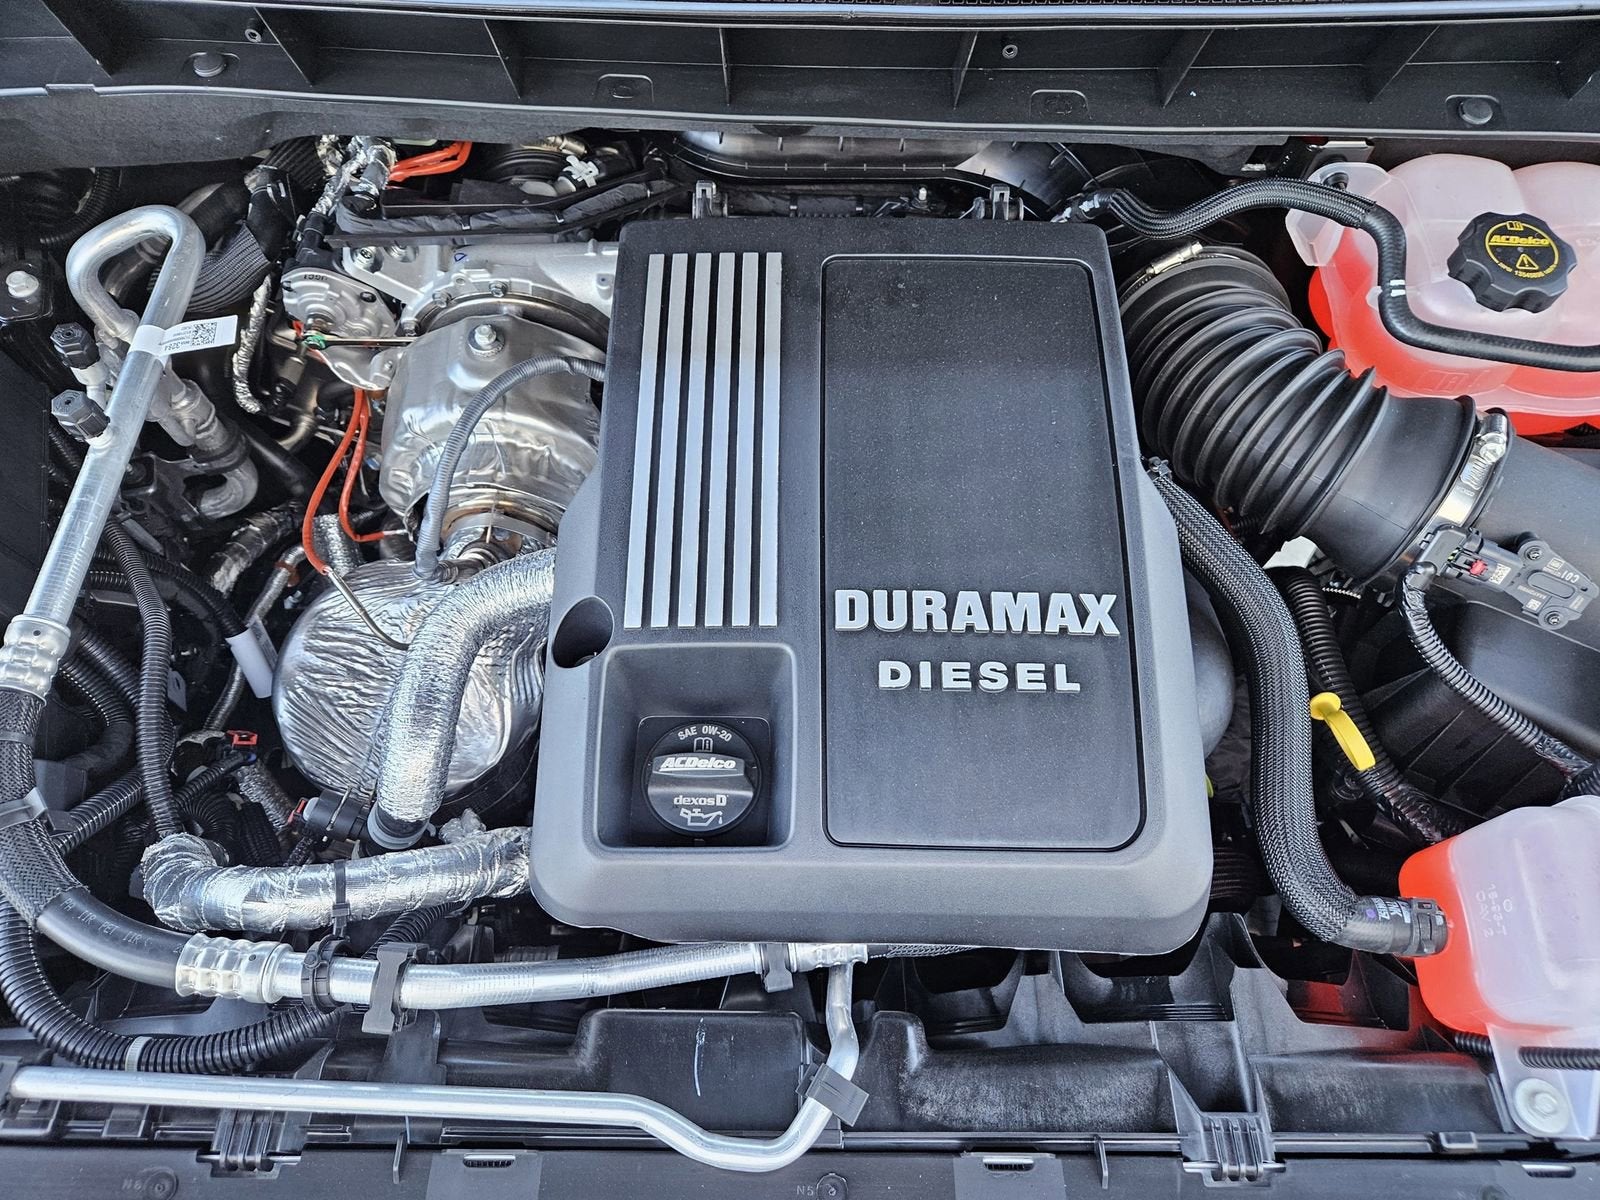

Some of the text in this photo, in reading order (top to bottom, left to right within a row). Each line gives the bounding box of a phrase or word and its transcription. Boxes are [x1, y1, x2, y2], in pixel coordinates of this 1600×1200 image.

[1490, 234, 1550, 246] ACDelco
[834, 589, 1121, 637] DURAMAX
[878, 660, 1082, 693] DIESEL
[677, 725, 732, 742] SAE 0W-20
[659, 757, 737, 771] ACDelco
[796, 1184, 814, 1196] N5
